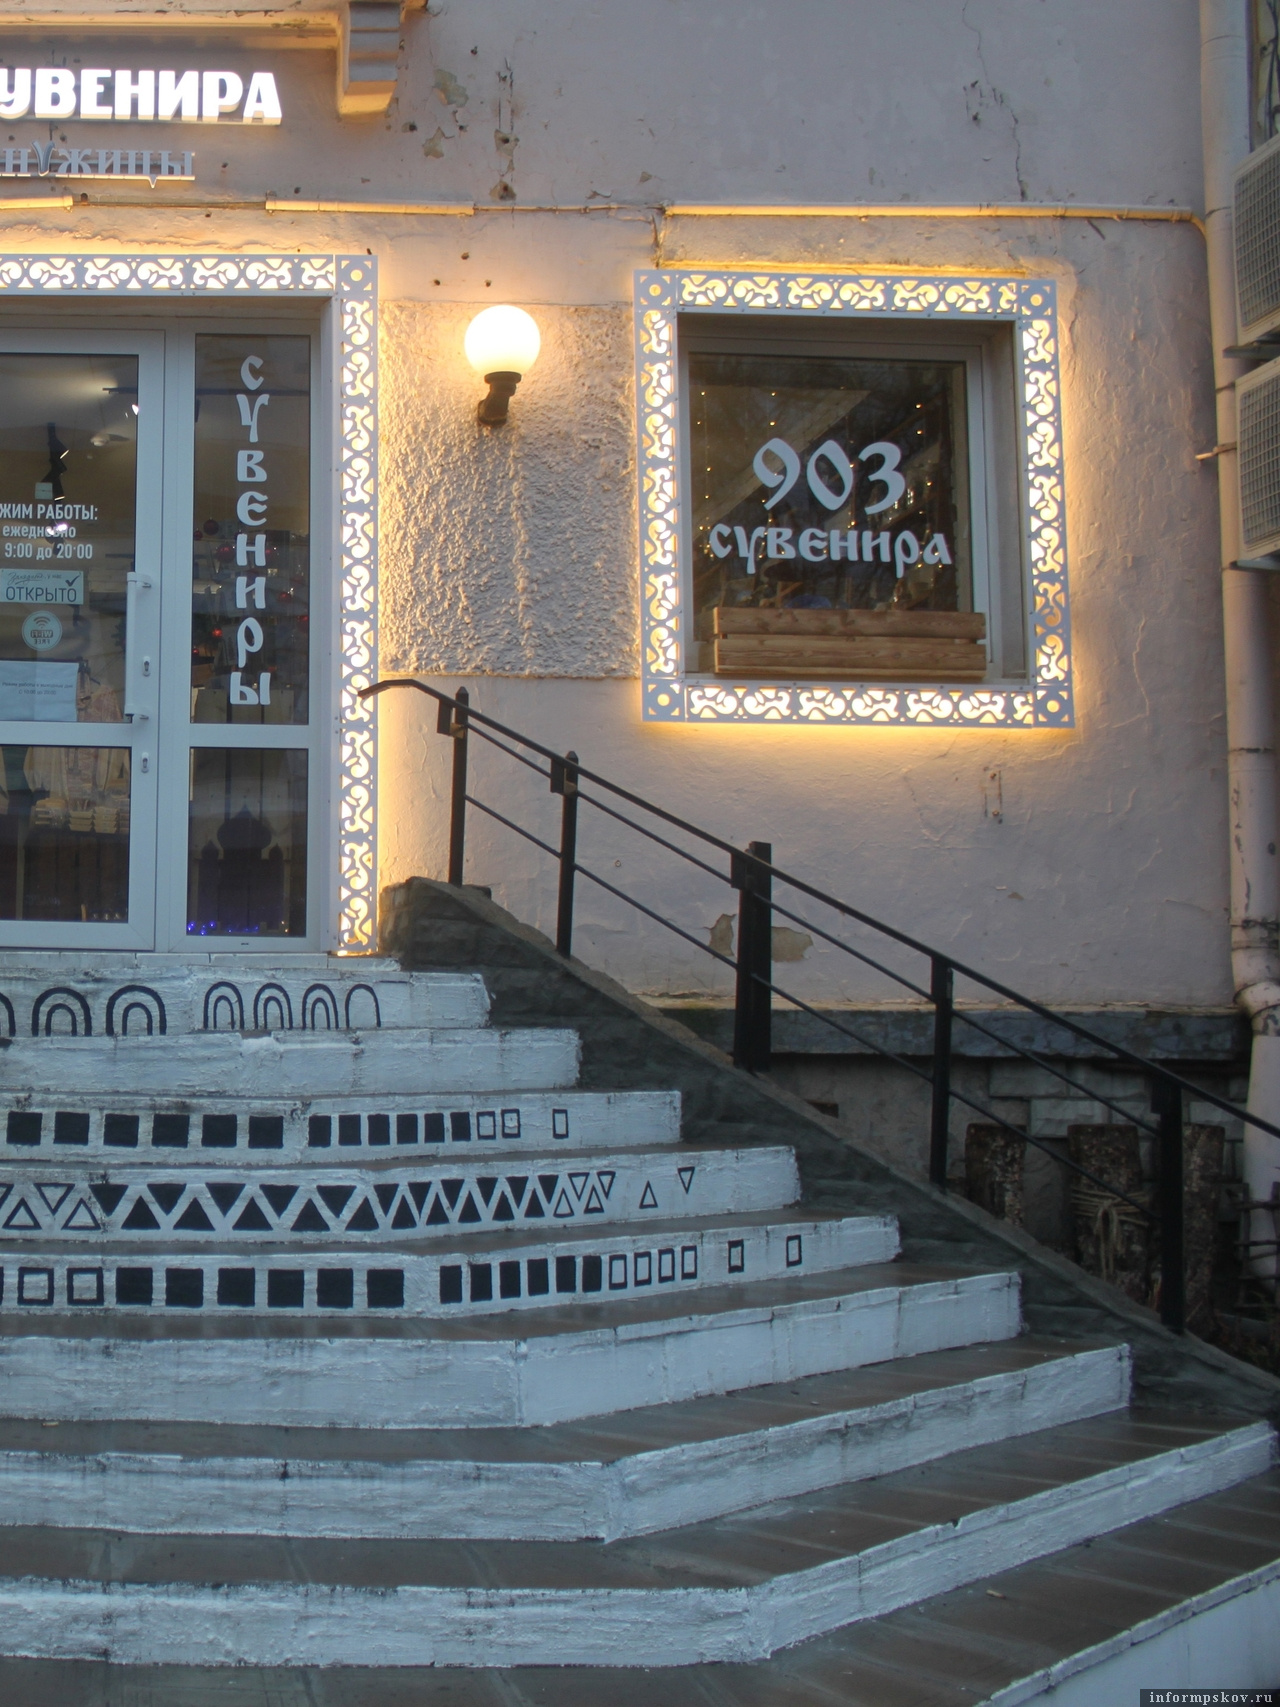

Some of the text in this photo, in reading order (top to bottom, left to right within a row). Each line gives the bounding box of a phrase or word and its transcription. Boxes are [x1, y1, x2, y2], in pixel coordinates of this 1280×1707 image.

[752, 437, 906, 515] 903
[36, 503, 99, 521] РАБОТЫ:
[4, 542, 33, 559] 9:00
[35, 546, 53, 561] до
[5, 586, 77, 603] ОТКРЫТО
